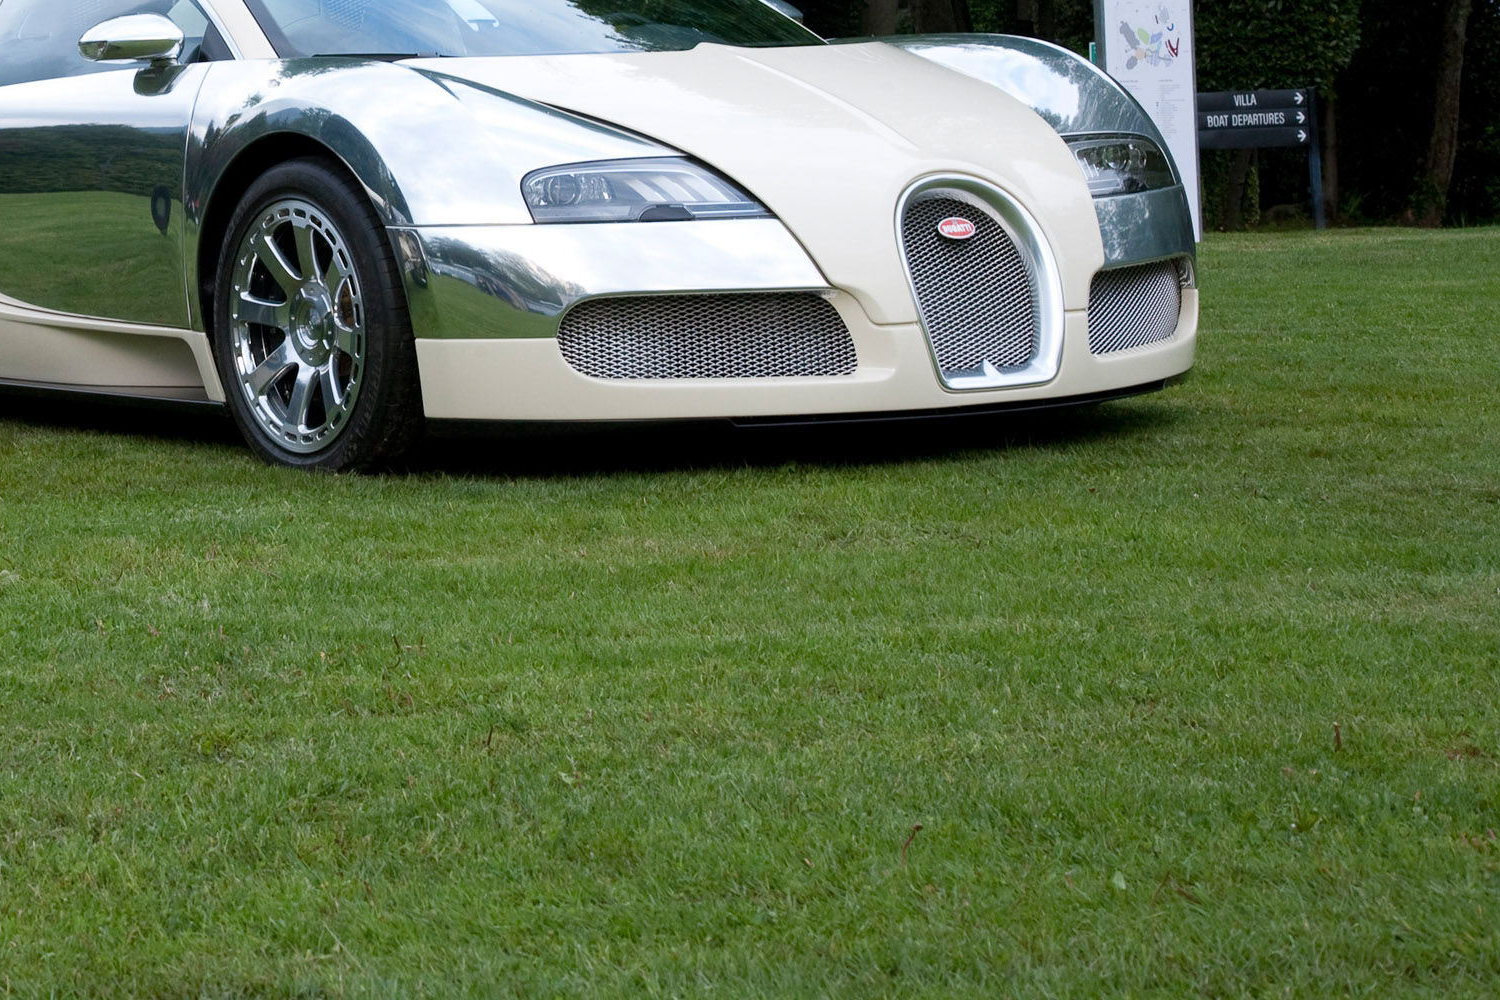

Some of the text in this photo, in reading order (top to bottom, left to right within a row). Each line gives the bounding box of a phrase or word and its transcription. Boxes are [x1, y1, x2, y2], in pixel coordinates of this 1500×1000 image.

[1234, 94, 1257, 106] VILLA
[1207, 112, 1285, 127] BOAT DEPARTURES
[941, 223, 972, 234] BUGATTI
